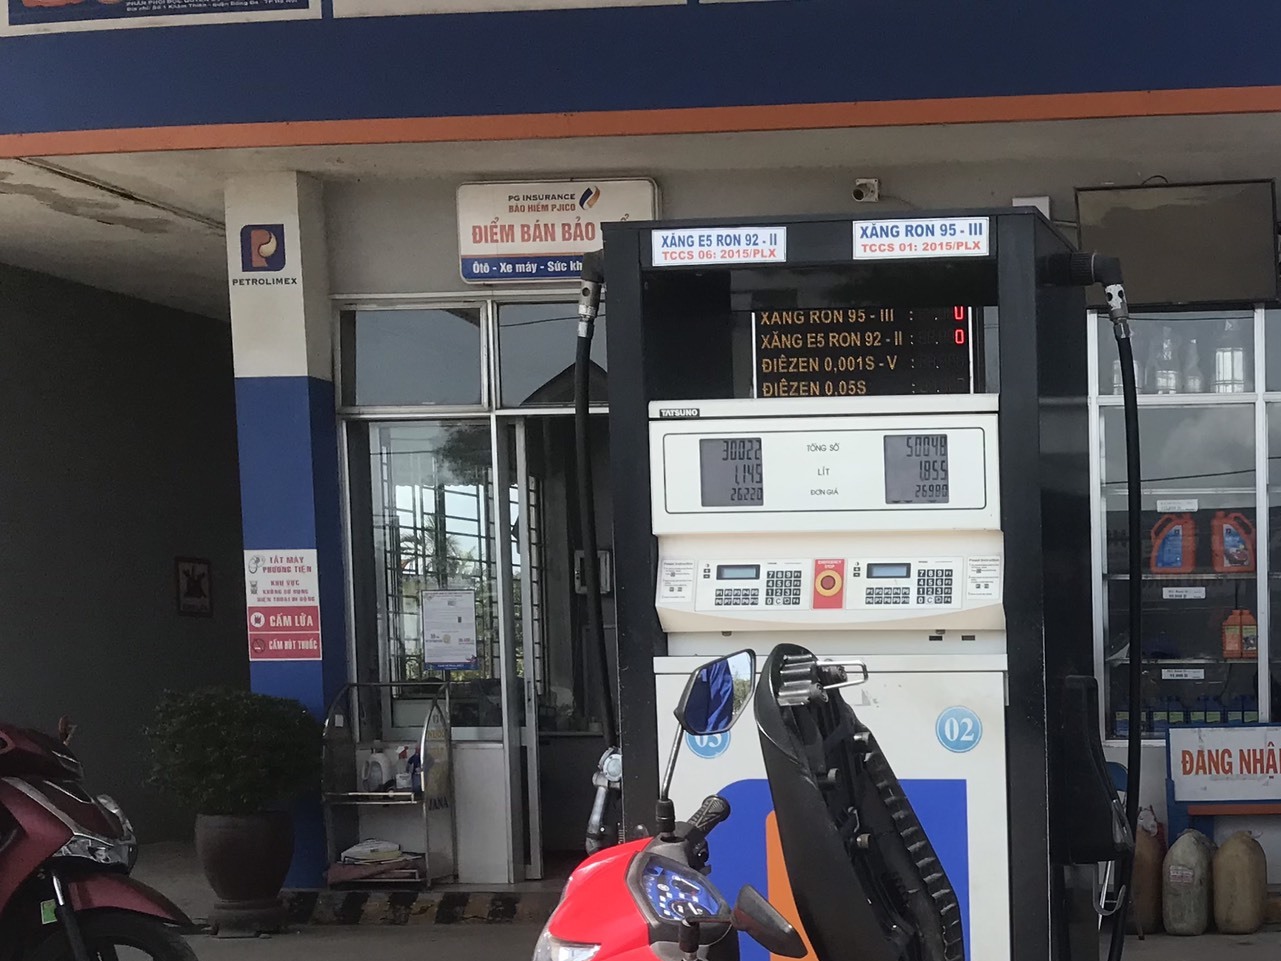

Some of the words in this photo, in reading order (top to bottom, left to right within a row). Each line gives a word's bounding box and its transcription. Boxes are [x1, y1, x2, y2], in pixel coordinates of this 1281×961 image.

[508, 194, 520, 202] PG
[522, 193, 576, 201] INSURANCE
[551, 203, 576, 212] PJICO
[472, 217, 515, 244] ĐIỂM
[520, 220, 555, 243] BÁN
[561, 216, 596, 242] BẢO
[860, 223, 900, 238] XĂNG
[905, 224, 935, 237] RON
[940, 223, 956, 236] 95
[969, 223, 983, 235] III
[661, 233, 694, 248] XĂNG
[698, 234, 712, 247] E5
[716, 234, 741, 247] RON
[744, 233, 759, 246] 92
[769, 233, 777, 246] II
[862, 243, 894, 253] TCCS
[899, 243, 917, 251] 01:
[922, 241, 981, 251] 2015/PLX
[662, 251, 694, 260] TCCS
[698, 250, 716, 259] 06:
[720, 249, 776, 258] 2015/PLX
[472, 260, 489, 273] Ôtô
[500, 262, 512, 273] Xe
[516, 261, 537, 274] máy
[547, 261, 567, 272] Sức
[232, 278, 297, 286] PETROLIMEX
[810, 309, 843, 324] RON
[848, 309, 865, 323] 95
[761, 331, 802, 349] XĂNG
[807, 333, 825, 348] E5
[829, 332, 860, 347] RON
[865, 332, 881, 346] 92
[954, 329, 964, 344] 0
[762, 354, 819, 373] ĐIÊZEN
[824, 356, 875, 374] 0,001S
[886, 355, 897, 370] V
[762, 379, 820, 397] ĐIÊZEN
[661, 409, 698, 417] TATSUNO
[722, 440, 762, 461] 30022
[817, 467, 830, 476] LÍT
[731, 488, 763, 501] 26220
[269, 613, 292, 627] CẤM
[294, 612, 314, 627] LỬA
[944, 716, 974, 742] 02
[1181, 748, 1233, 775] ĐANG
